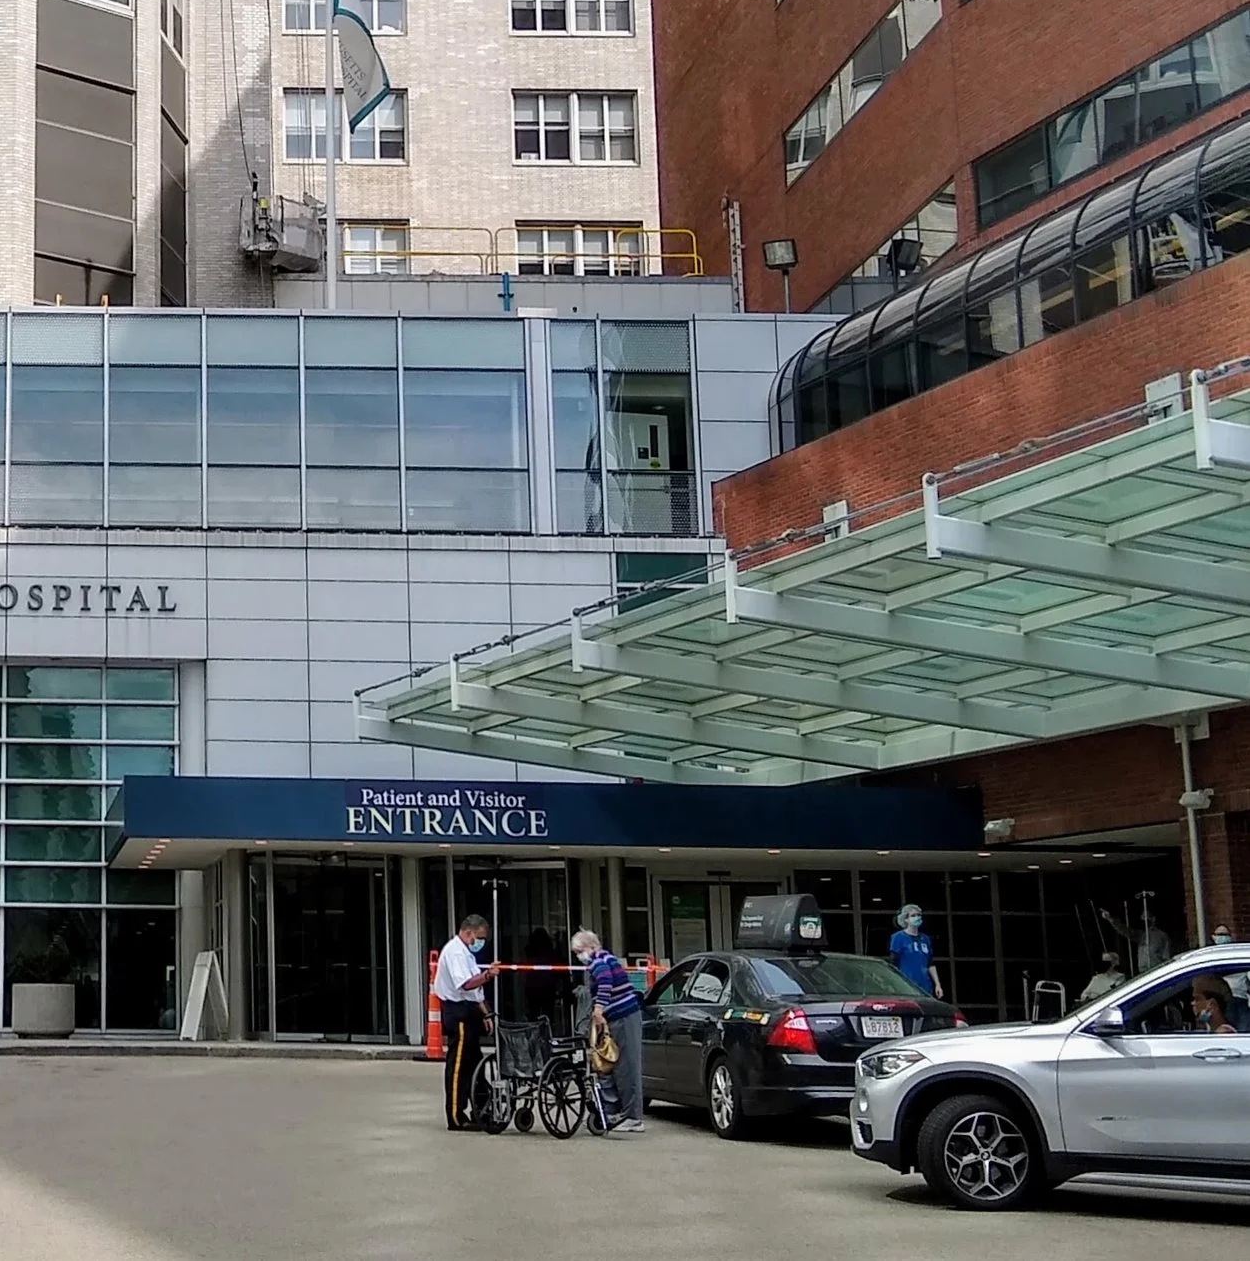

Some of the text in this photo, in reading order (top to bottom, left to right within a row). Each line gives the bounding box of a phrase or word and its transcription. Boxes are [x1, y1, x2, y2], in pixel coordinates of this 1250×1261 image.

[360, 788, 527, 809] Patient and Visitor
[345, 806, 549, 837] ENTRANCE
